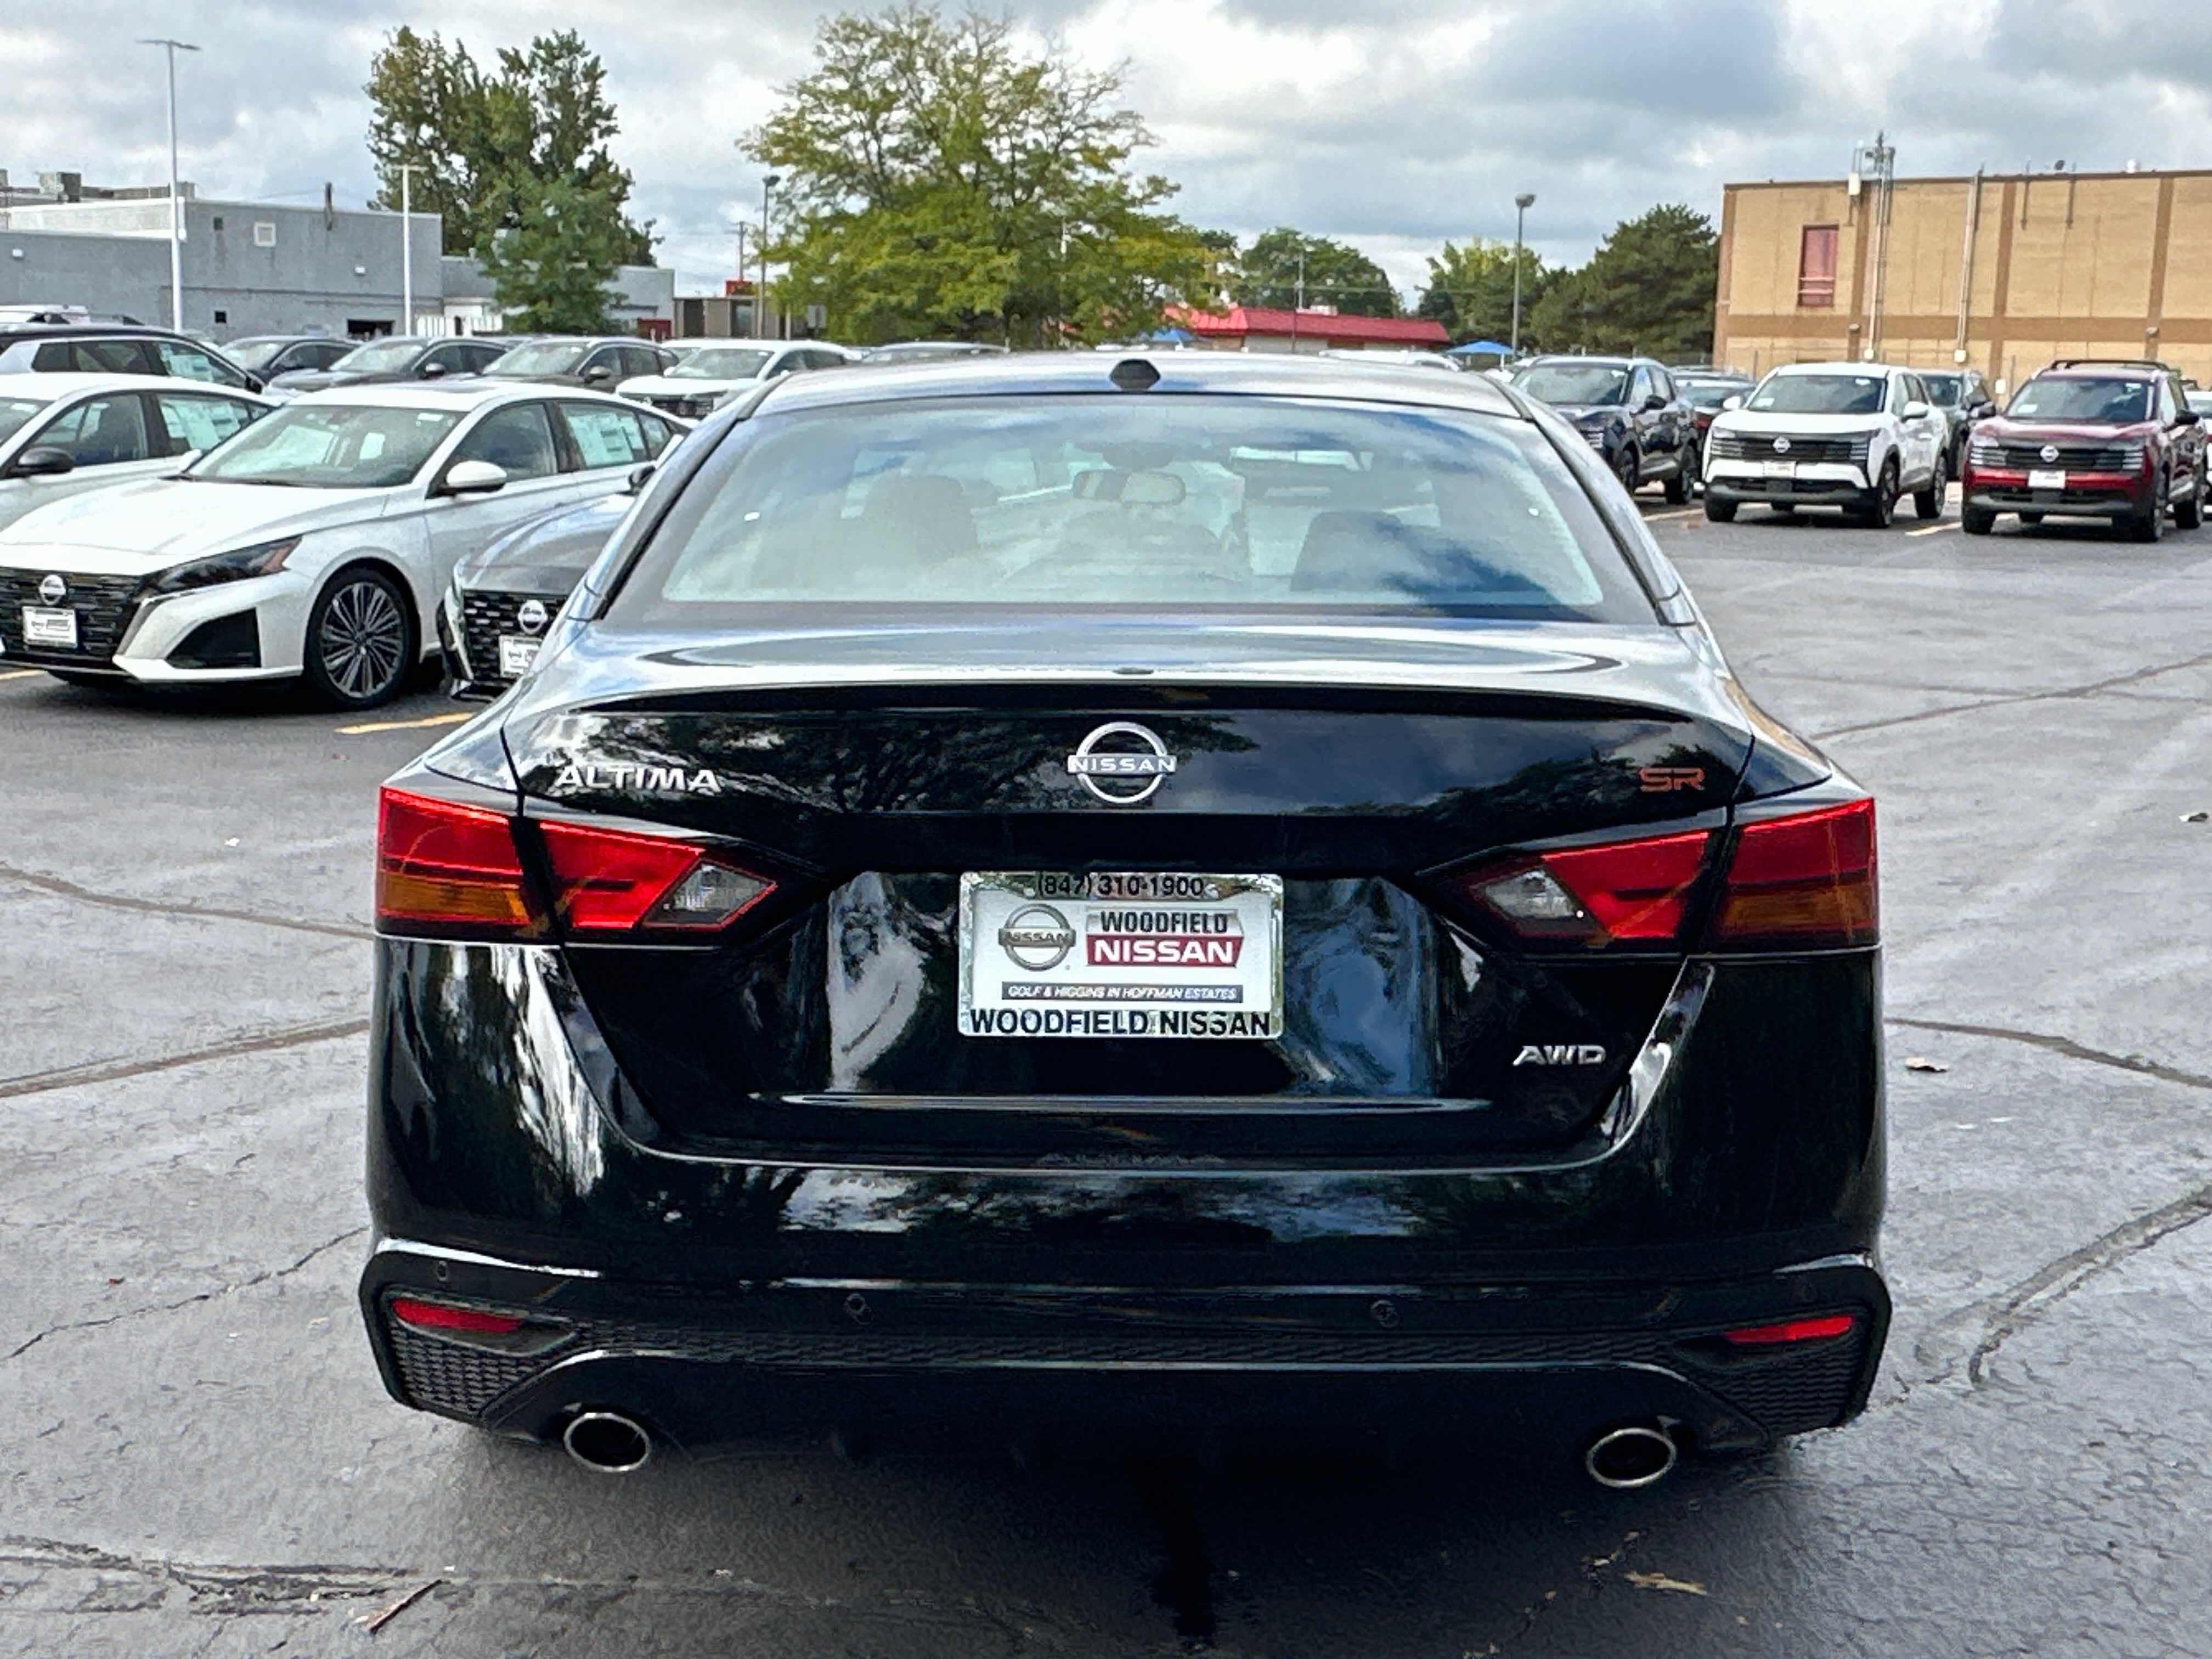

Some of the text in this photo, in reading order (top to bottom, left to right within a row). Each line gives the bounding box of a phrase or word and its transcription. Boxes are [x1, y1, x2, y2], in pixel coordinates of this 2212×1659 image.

[1071, 758, 1175, 771] NISSAN
[554, 766, 722, 793] ALTIMA
[1640, 768, 1705, 792] SR
[1038, 874, 1204, 897] (847) 310-1900
[1101, 911, 1228, 934] WOODFIELD
[1094, 939, 1233, 963] NISSAN
[1008, 986, 1042, 997] GOLF
[1122, 988, 1181, 999] HOFFMAN
[1184, 988, 1237, 1000] ESTATES
[970, 1008, 1270, 1036] WOODFIELD NISSAN
[1513, 1044, 1607, 1066] AWD
